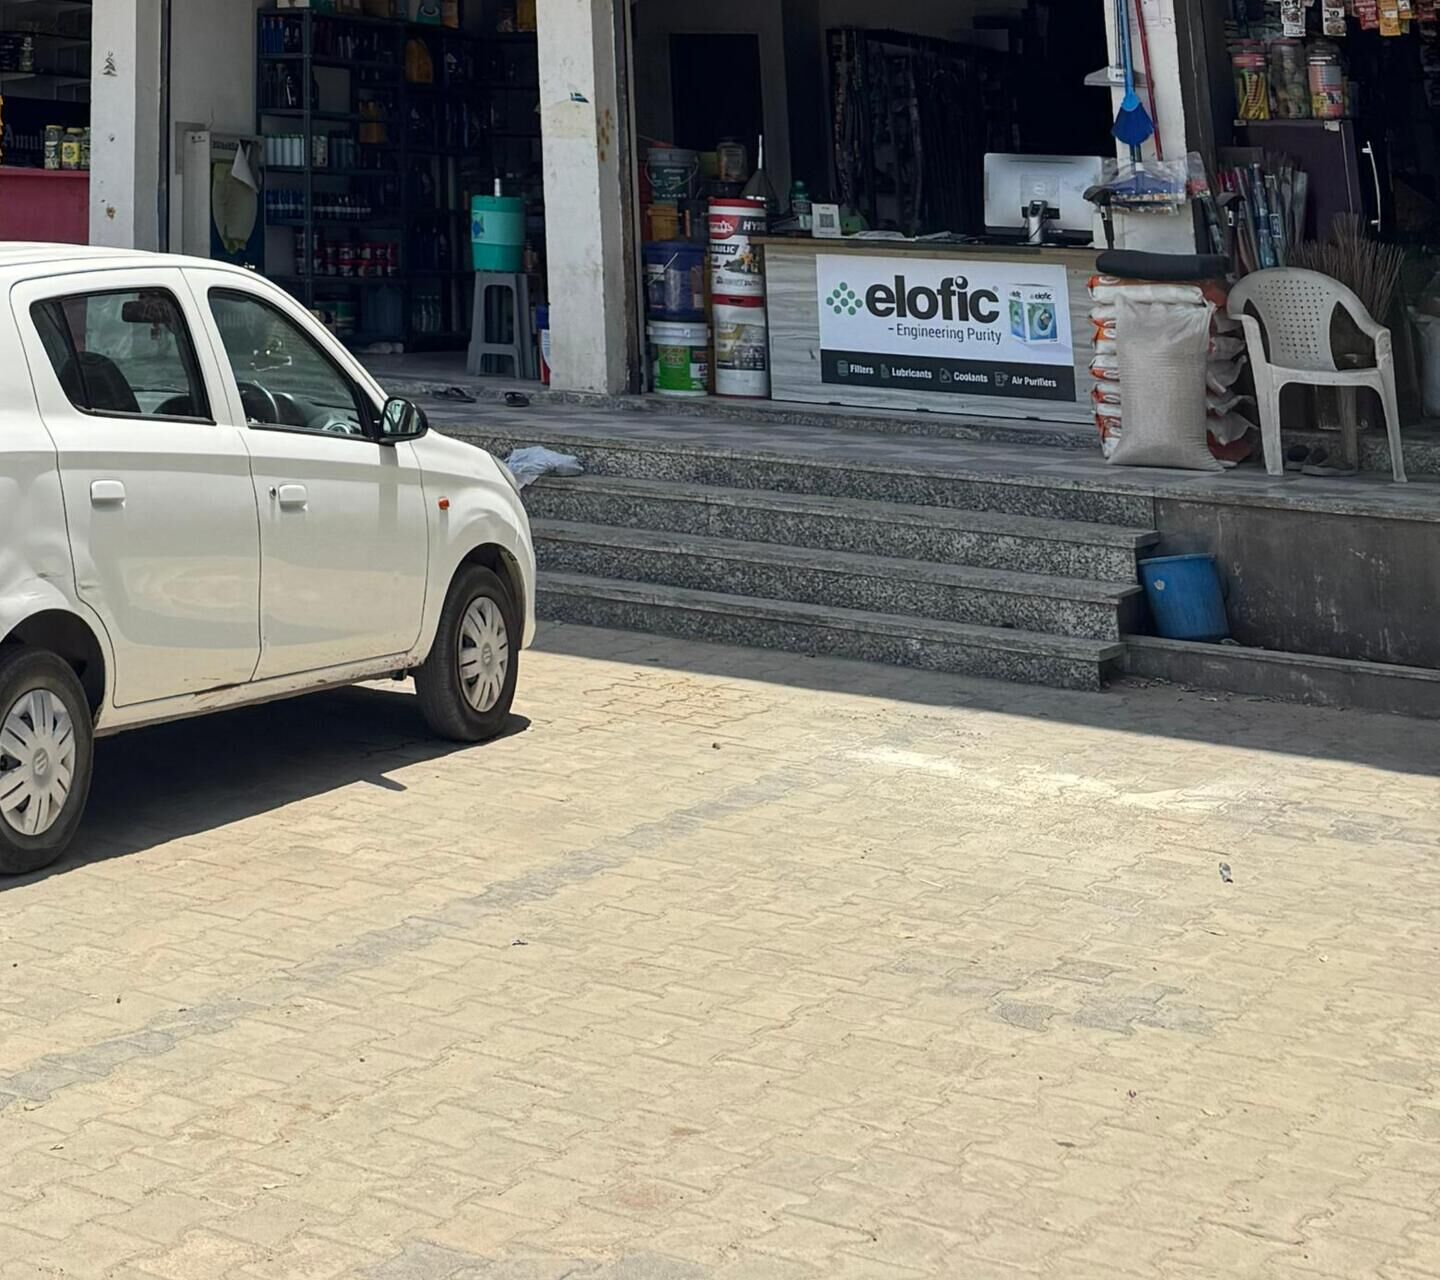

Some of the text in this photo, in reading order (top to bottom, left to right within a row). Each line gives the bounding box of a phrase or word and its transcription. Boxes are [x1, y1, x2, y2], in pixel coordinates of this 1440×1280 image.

[866, 275, 1000, 324] elofic
[897, 324, 1002, 345] Engineering Purity
[850, 365, 1057, 387] Filters Lubricants Coolants Air Purifiers
